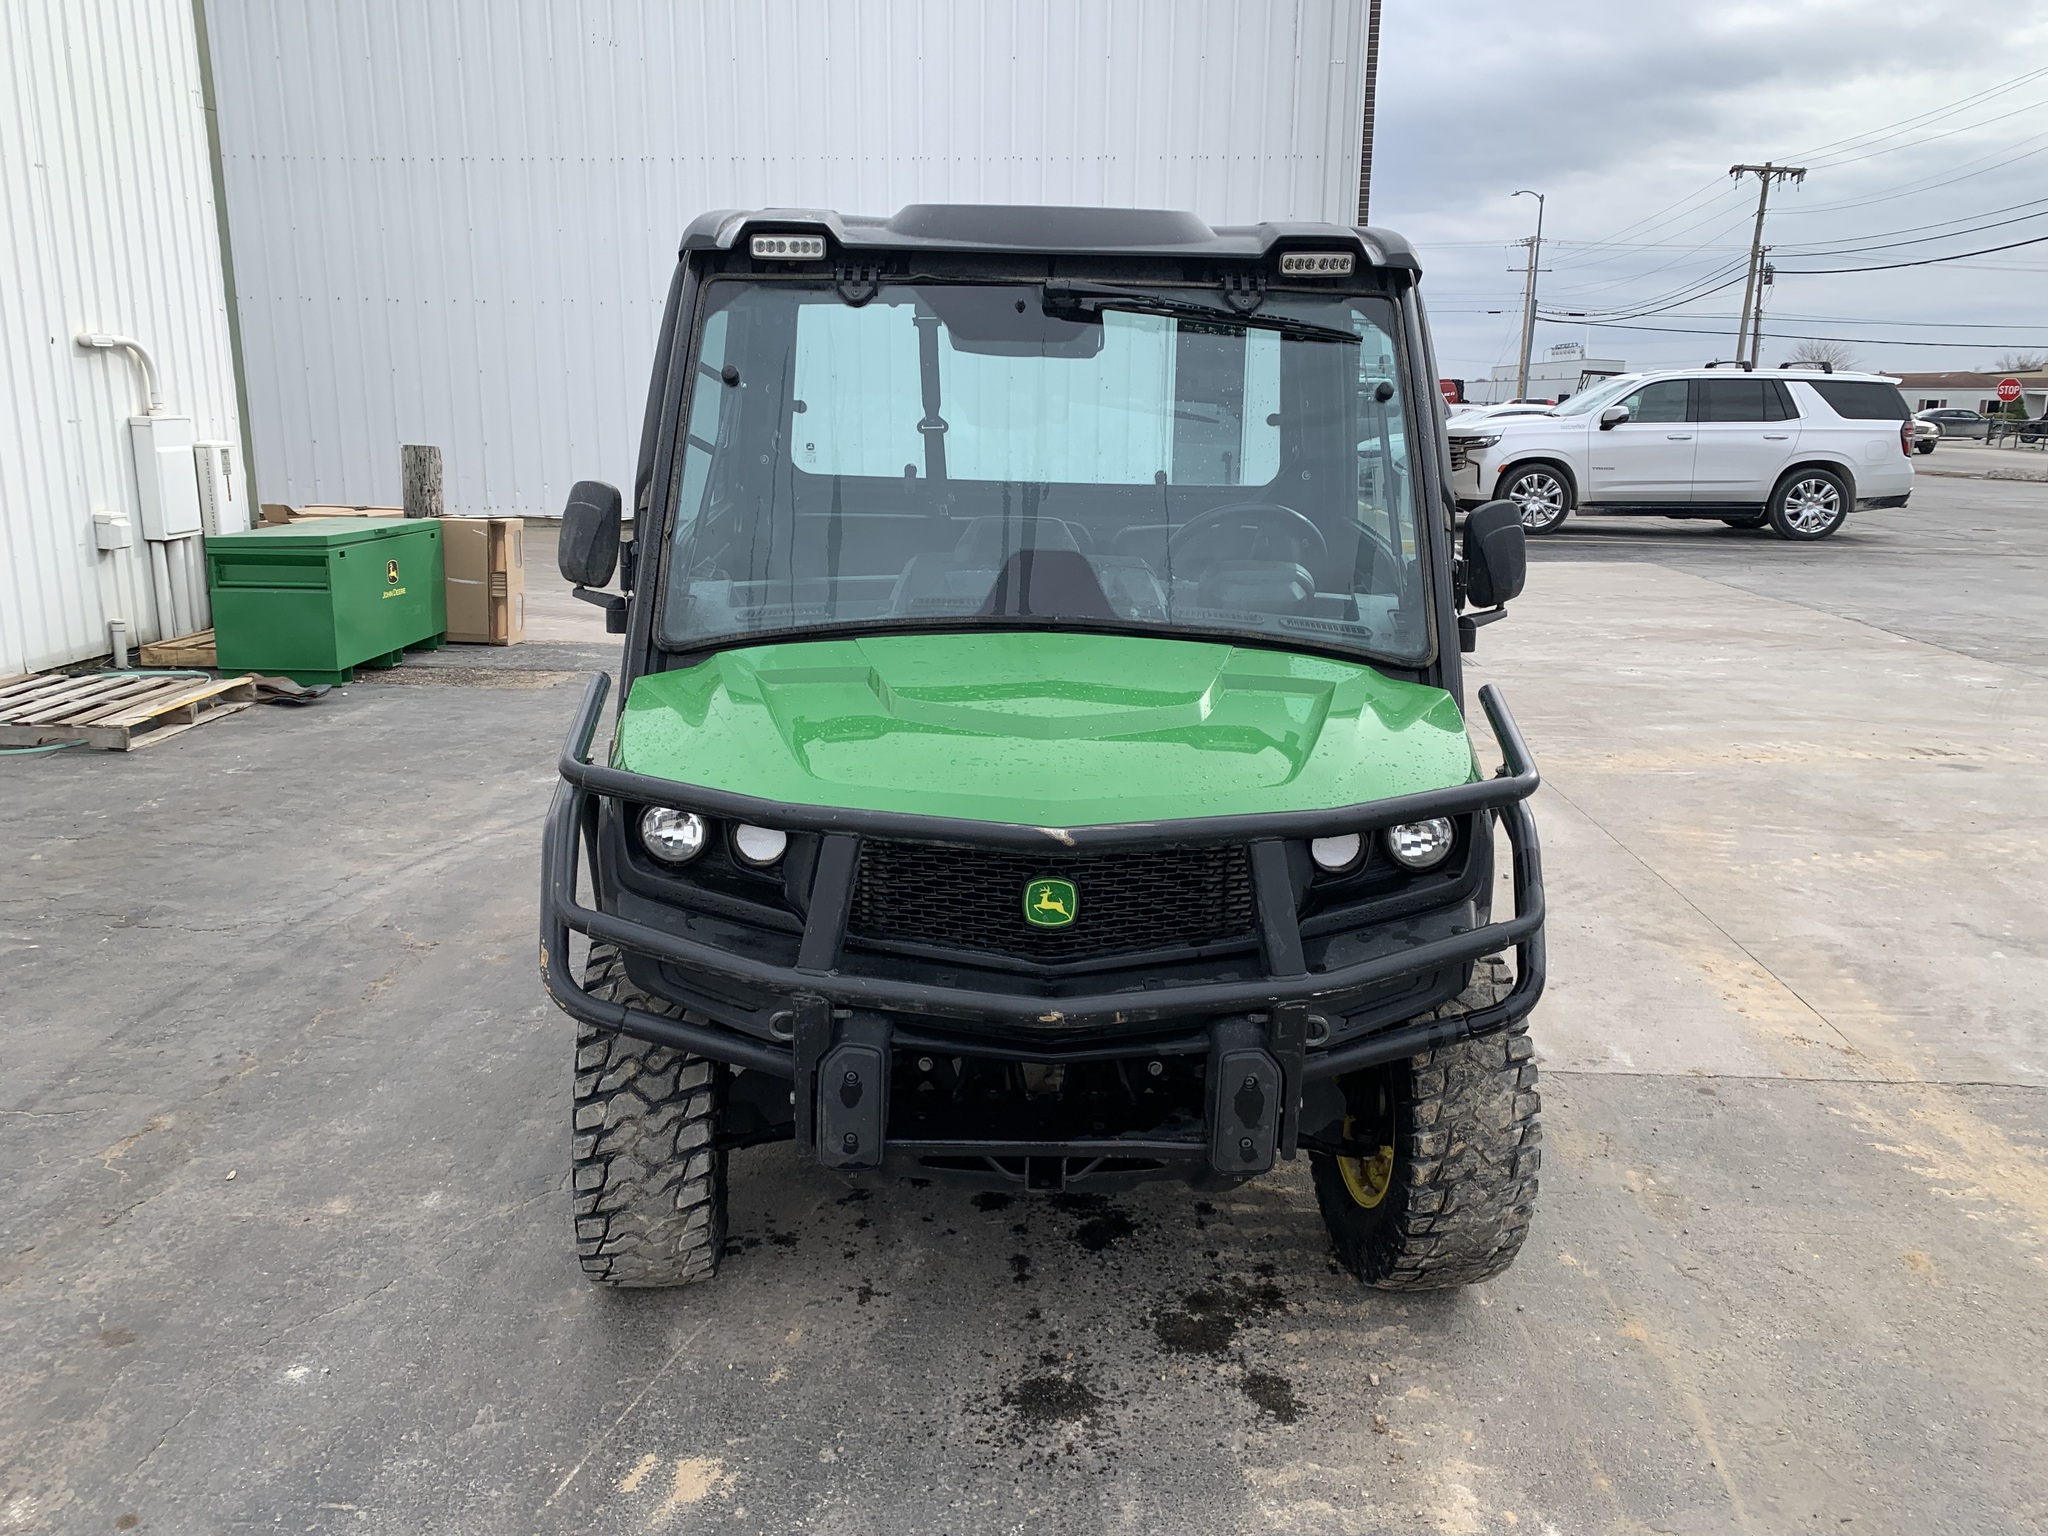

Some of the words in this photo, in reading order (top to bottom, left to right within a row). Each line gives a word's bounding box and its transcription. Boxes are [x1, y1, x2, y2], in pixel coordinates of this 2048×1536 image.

[1998, 385, 2020, 395] STOP
[382, 591, 393, 599] JOHN
[393, 587, 406, 597] DEERE
